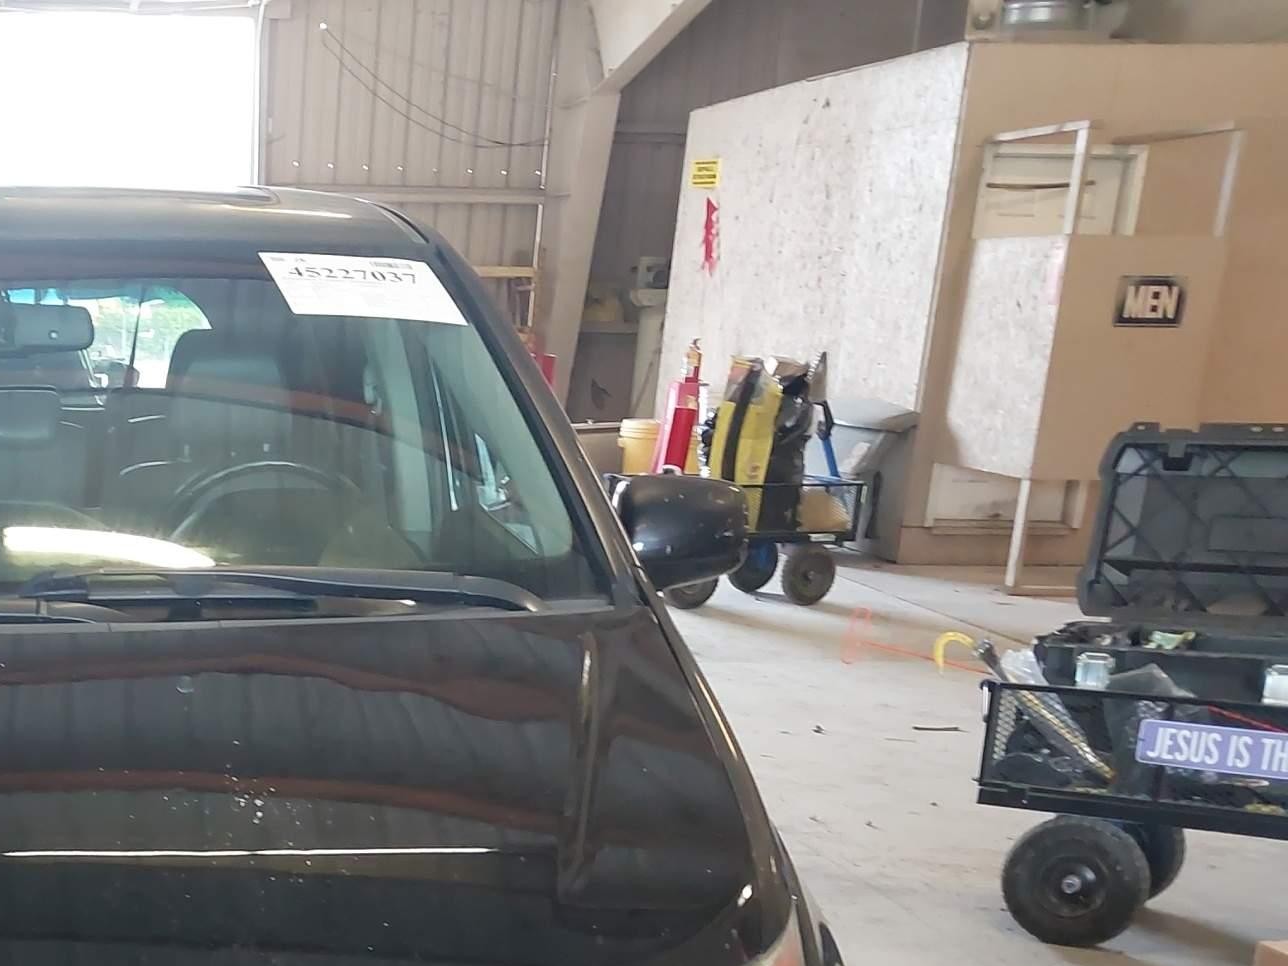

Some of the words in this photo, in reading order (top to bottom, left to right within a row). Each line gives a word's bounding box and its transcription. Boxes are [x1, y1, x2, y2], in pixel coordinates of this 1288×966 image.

[289, 266, 416, 285] 45227037
[1123, 285, 1179, 319] MEN
[1146, 727, 1222, 765] JESUS
[1227, 734, 1253, 768] IS
